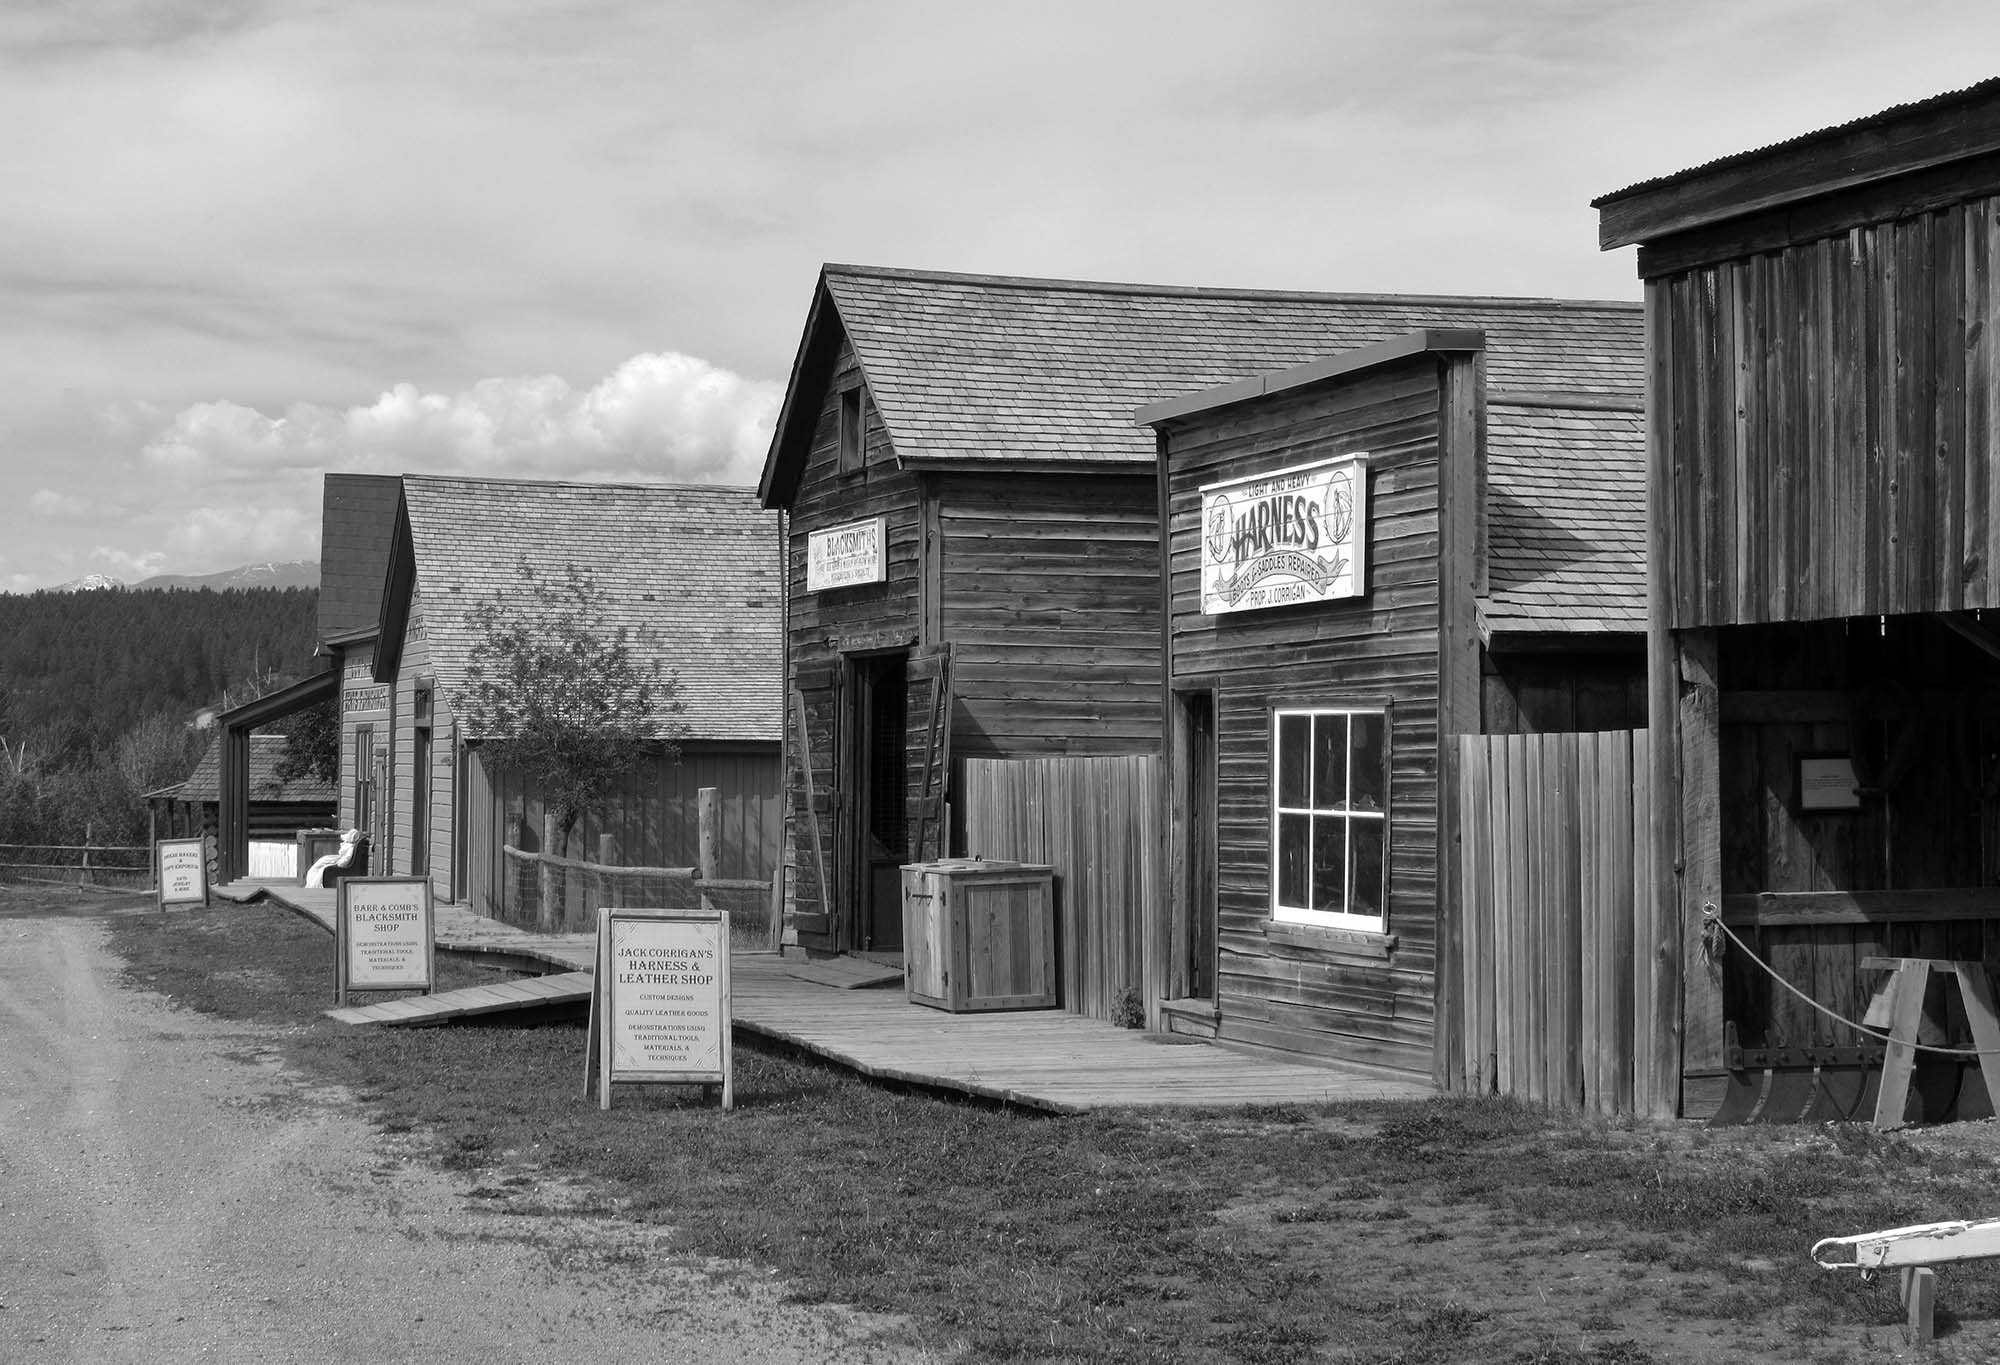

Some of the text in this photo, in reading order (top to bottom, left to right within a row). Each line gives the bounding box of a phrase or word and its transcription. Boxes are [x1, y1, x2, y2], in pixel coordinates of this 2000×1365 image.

[1248, 473, 1310, 497] LIGHT AND HEAVY
[1231, 495, 1320, 569] HARNESS
[827, 528, 876, 557] BLACKSMITHS
[1232, 572, 1251, 601] BOOTS
[1257, 554, 1286, 576] SADDLES
[1287, 554, 1320, 585] REPAIRED
[1273, 584, 1306, 604] CORRIGAN
[353, 904, 378, 912] BARR
[388, 904, 419, 912] COMB'S
[355, 913, 418, 921] BLACKSMITH
[374, 924, 400, 933] SHOP
[617, 948, 714, 959] JACK CORRIGAN'S
[629, 960, 701, 972] HARNESS &
[619, 973, 714, 985] LEATHER SHOP
[639, 993, 666, 1001] CUSTOM
[655, 1009, 686, 1017] LEATHER
[628, 1023, 686, 1031] DEMONSTRATIONS
